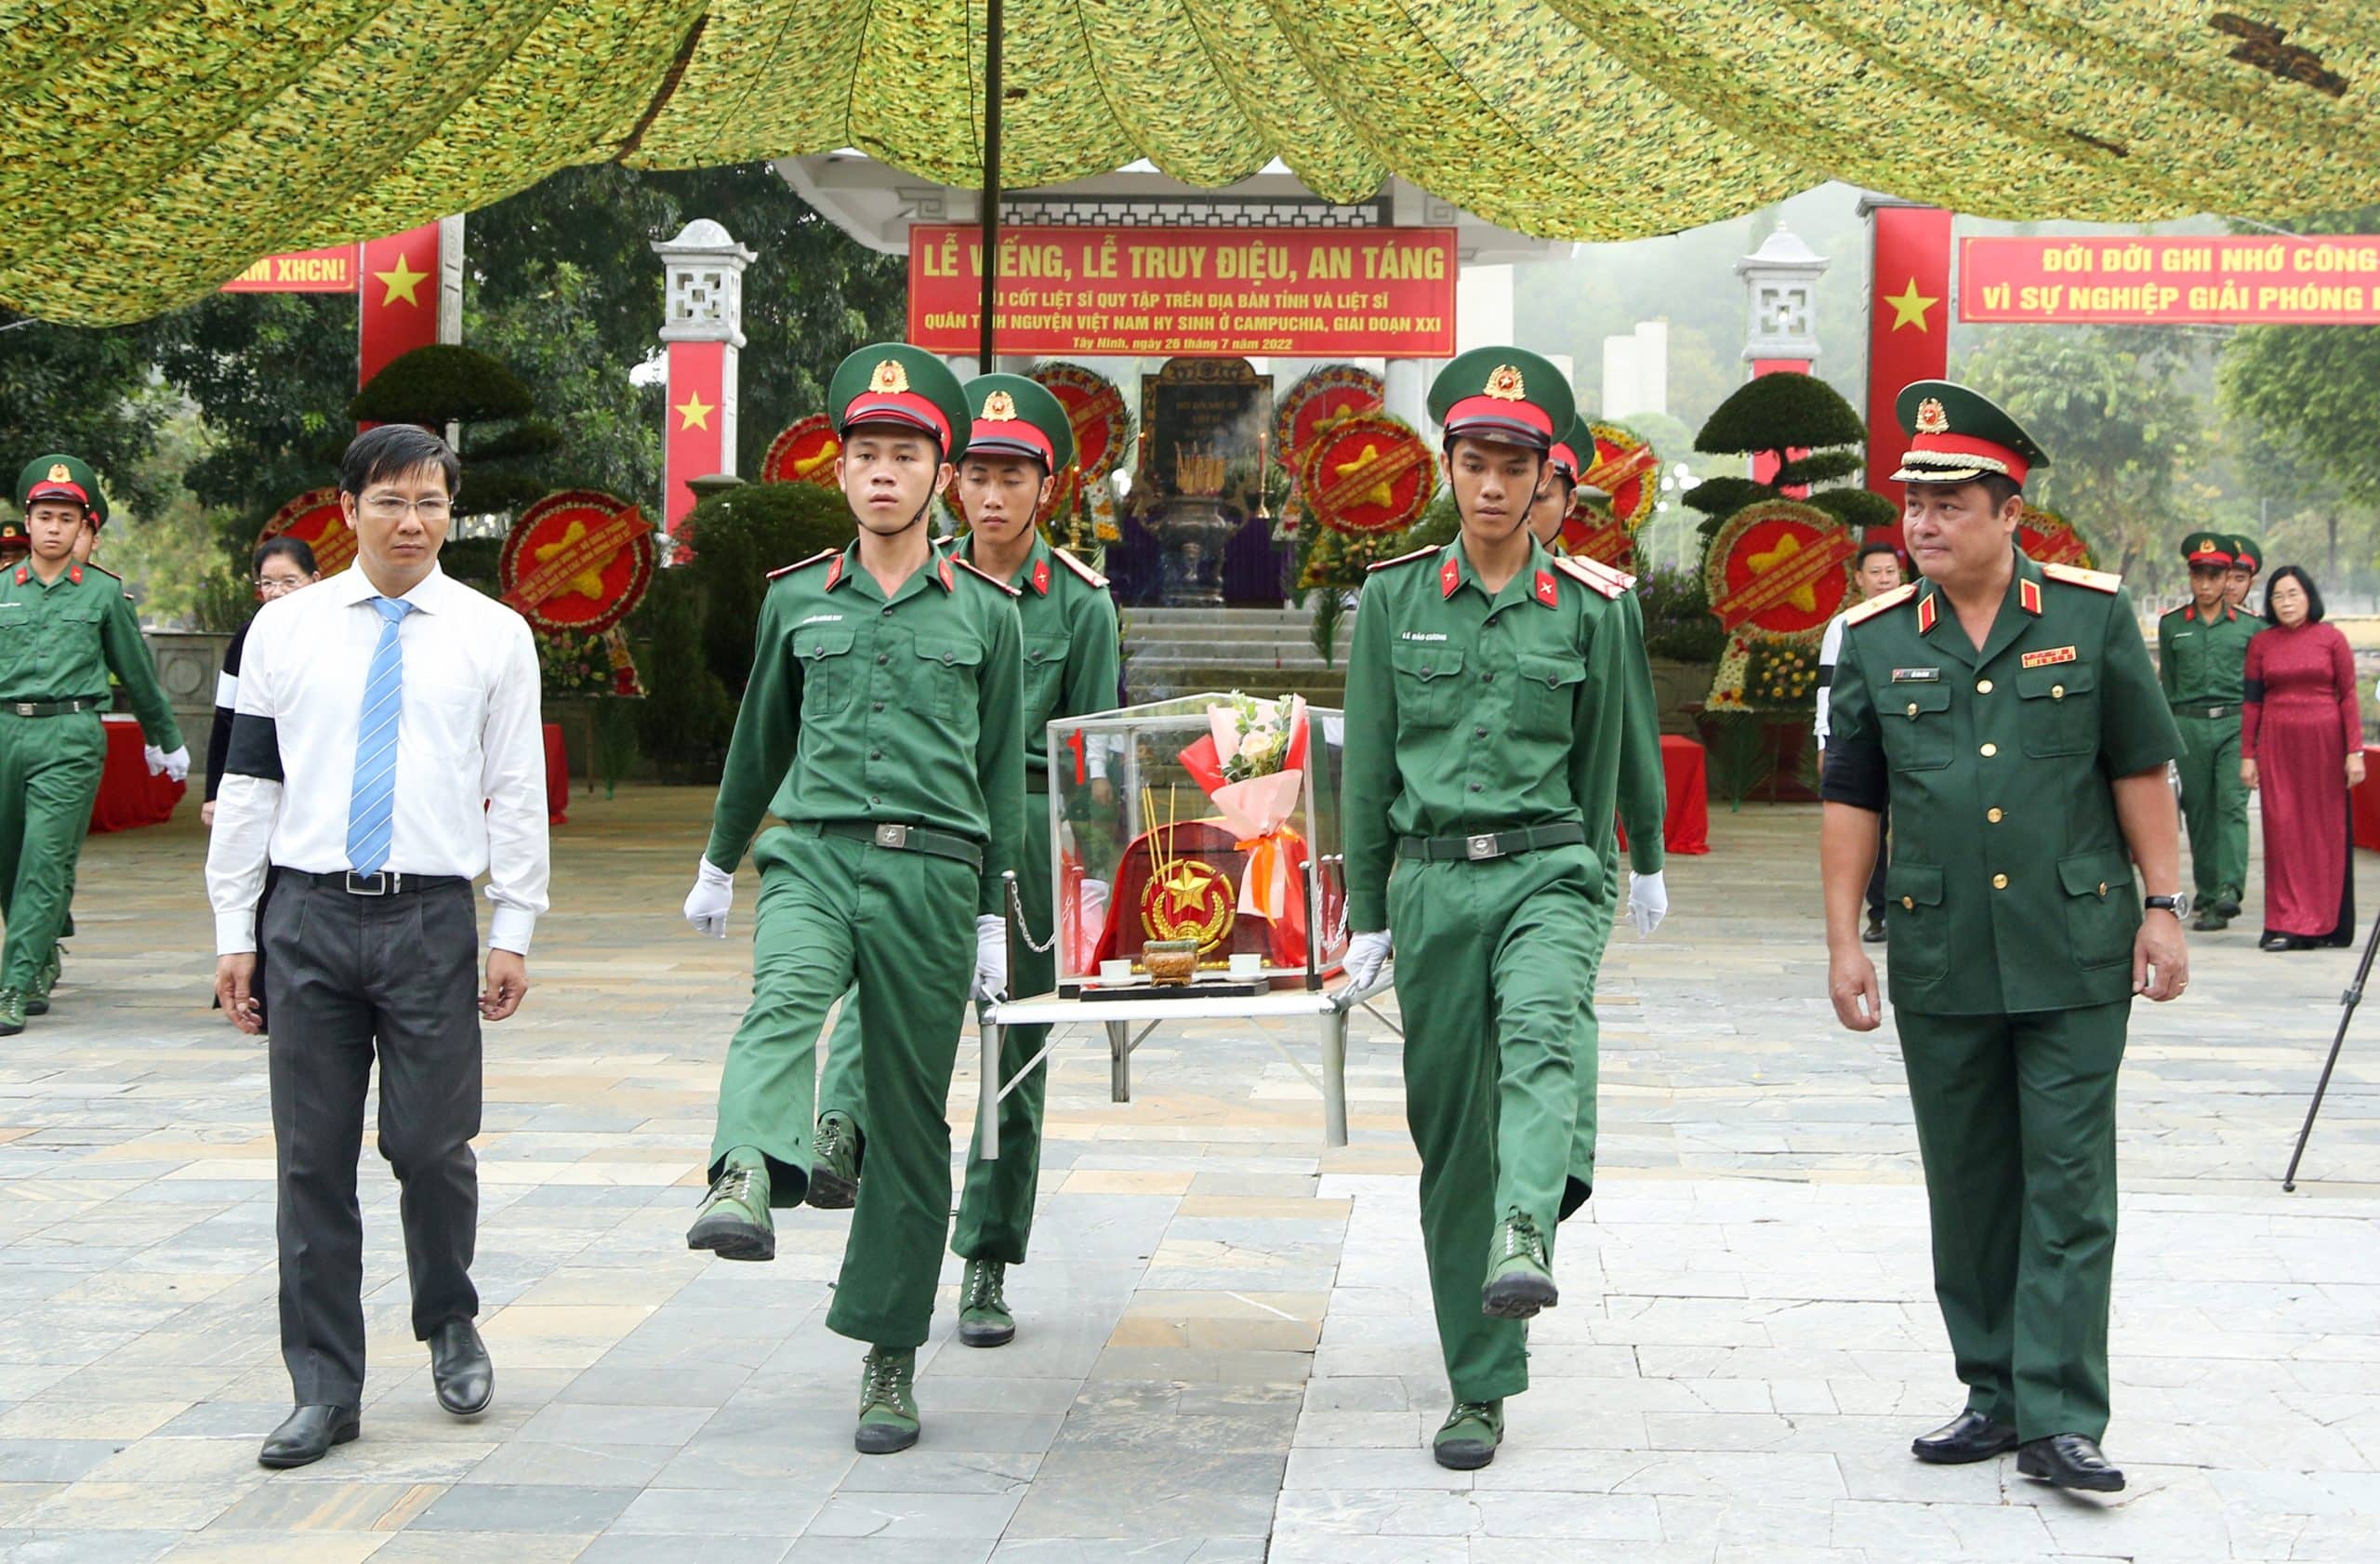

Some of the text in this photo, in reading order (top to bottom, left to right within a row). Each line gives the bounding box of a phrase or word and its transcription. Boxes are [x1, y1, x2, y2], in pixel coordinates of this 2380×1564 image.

[923, 232, 959, 277] LỄ
[1082, 234, 1117, 278] LỄ
[1128, 246, 1207, 279] TRUY
[1216, 239, 1298, 286] ĐIỆU,
[1307, 246, 1352, 279] AN
[1361, 240, 1445, 280] TÁNG
[2043, 243, 2378, 272] ĐỜI ĐỜI GHI NHỚ CÔNG
[276, 258, 346, 282] XHCN!
[1009, 287, 1038, 307] CỐT
[1041, 289, 1073, 311] LIỆT
[1097, 292, 1127, 309] QUY
[1130, 291, 1160, 311] TẬP
[1164, 291, 1203, 308] TRÊN
[1337, 291, 1368, 311] LIỆT
[1982, 282, 2011, 311] VÌ
[2019, 284, 2064, 315] SỰ
[2068, 282, 2180, 316] NGHIỆP
[2188, 279, 2250, 311] GIẢI
[2258, 282, 2364, 311] PHÓNG
[924, 311, 967, 330] QUÂN
[1011, 311, 1073, 333] NGUYỆN
[1077, 312, 1109, 333] VIỆT
[1114, 315, 1149, 331] NAM
[1153, 315, 1172, 331] HY
[1177, 315, 1214, 331] SINH
[1219, 311, 1231, 331] Ở
[1234, 315, 1329, 333] CAMPUCHIA,
[1333, 316, 1365, 332] GIAI
[1368, 316, 1410, 335] ĐOẠN
[1415, 317, 1441, 333] XXI
[1073, 337, 1094, 350] Tây
[1097, 338, 1129, 350] Ninh,
[1132, 338, 1162, 351] ngày
[1183, 338, 1219, 351] tháng
[1222, 338, 1229, 350] 7
[1232, 338, 1259, 350] năm
[1262, 338, 1293, 351] 2022
